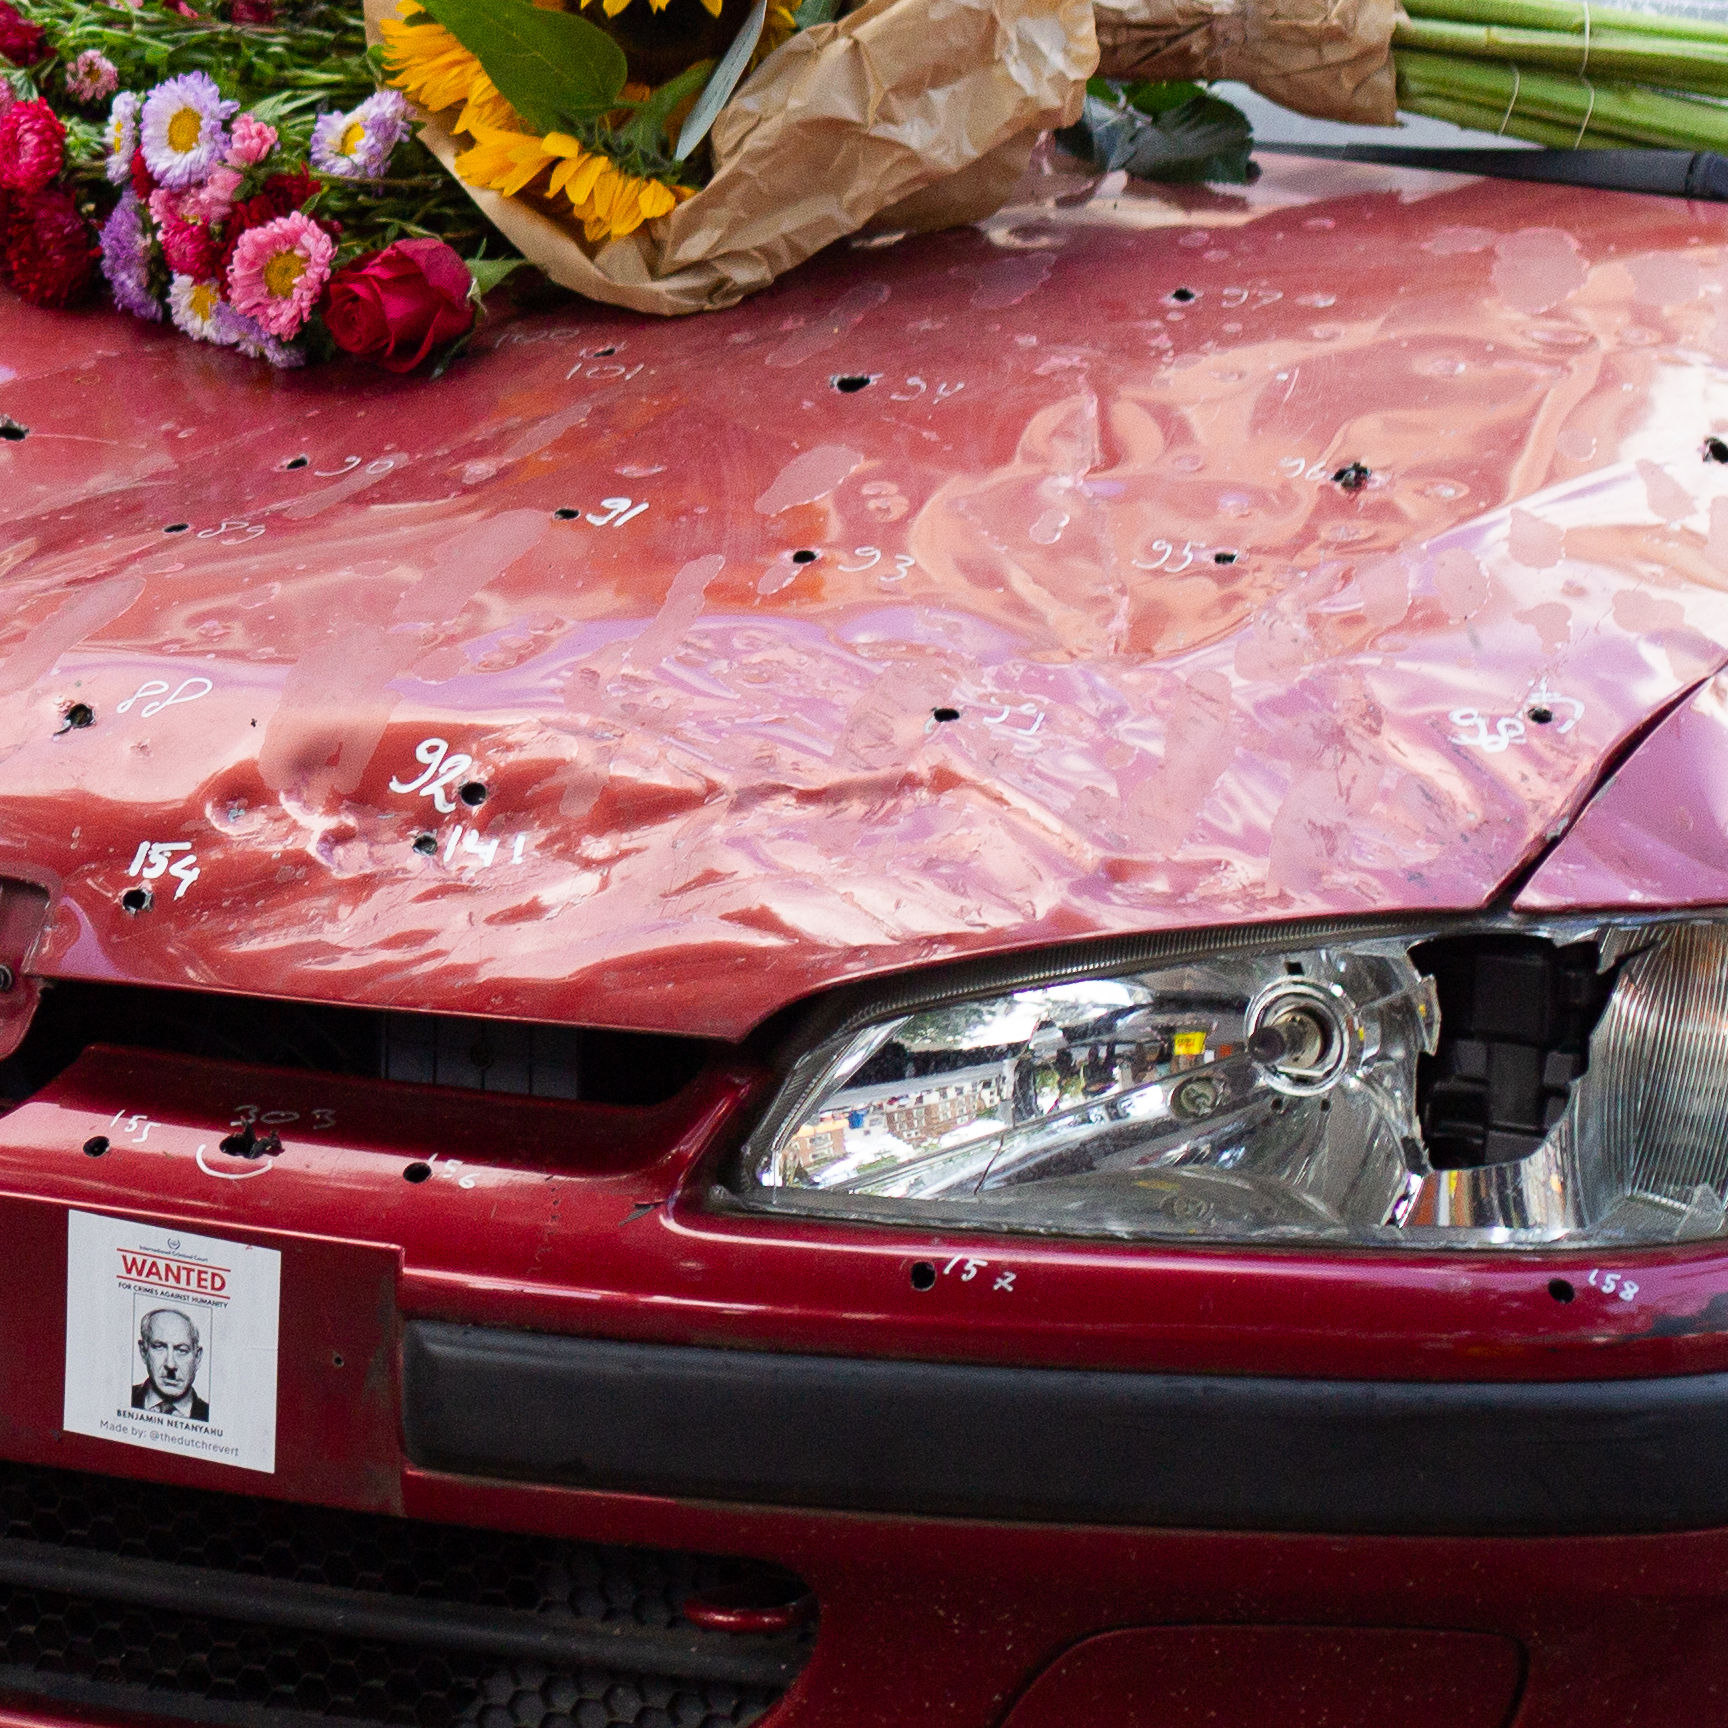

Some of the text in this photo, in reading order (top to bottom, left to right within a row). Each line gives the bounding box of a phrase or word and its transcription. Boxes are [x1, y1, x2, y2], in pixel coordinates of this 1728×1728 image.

[313, 455, 396, 477] 90
[585, 496, 650, 528] 91
[838, 545, 916, 583] 93
[1131, 539, 1207, 574] 95
[116, 677, 214, 718] 88
[388, 737, 474, 814] 92
[128, 840, 201, 901] 154
[110, 1109, 162, 1143] 155
[121, 1254, 227, 1292] WANTED
[1588, 1268, 1640, 1302] 158
[117, 1281, 228, 1308] FOR CRIMES AGAINST HUMANITY
[99, 1419, 129, 1433] Made
[130, 1425, 147, 1439] by:
[116, 1408, 224, 1438] BENJAMIN NETANYAHU
